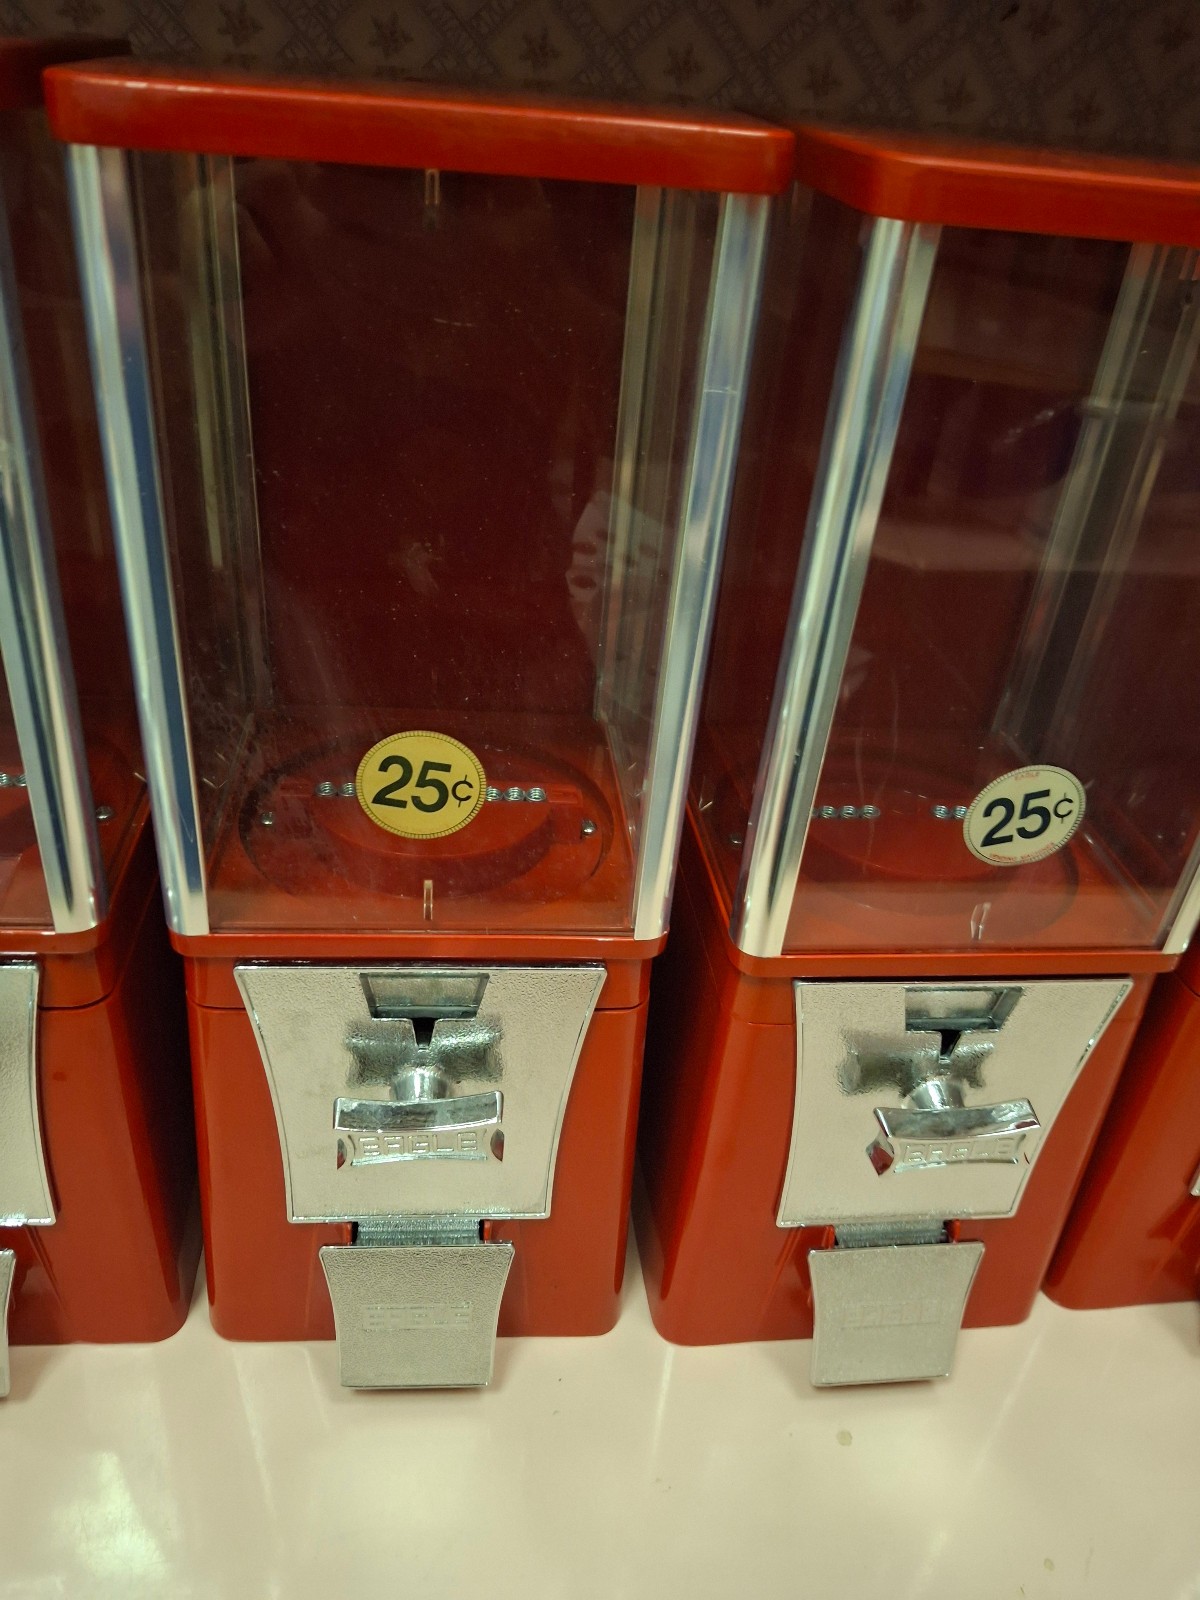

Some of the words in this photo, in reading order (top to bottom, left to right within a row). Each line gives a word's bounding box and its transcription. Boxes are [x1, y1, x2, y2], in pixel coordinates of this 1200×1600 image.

[371, 755, 473, 813] 25¢
[980, 789, 1074, 848] 25¢
[358, 1131, 477, 1156] EAGLE
